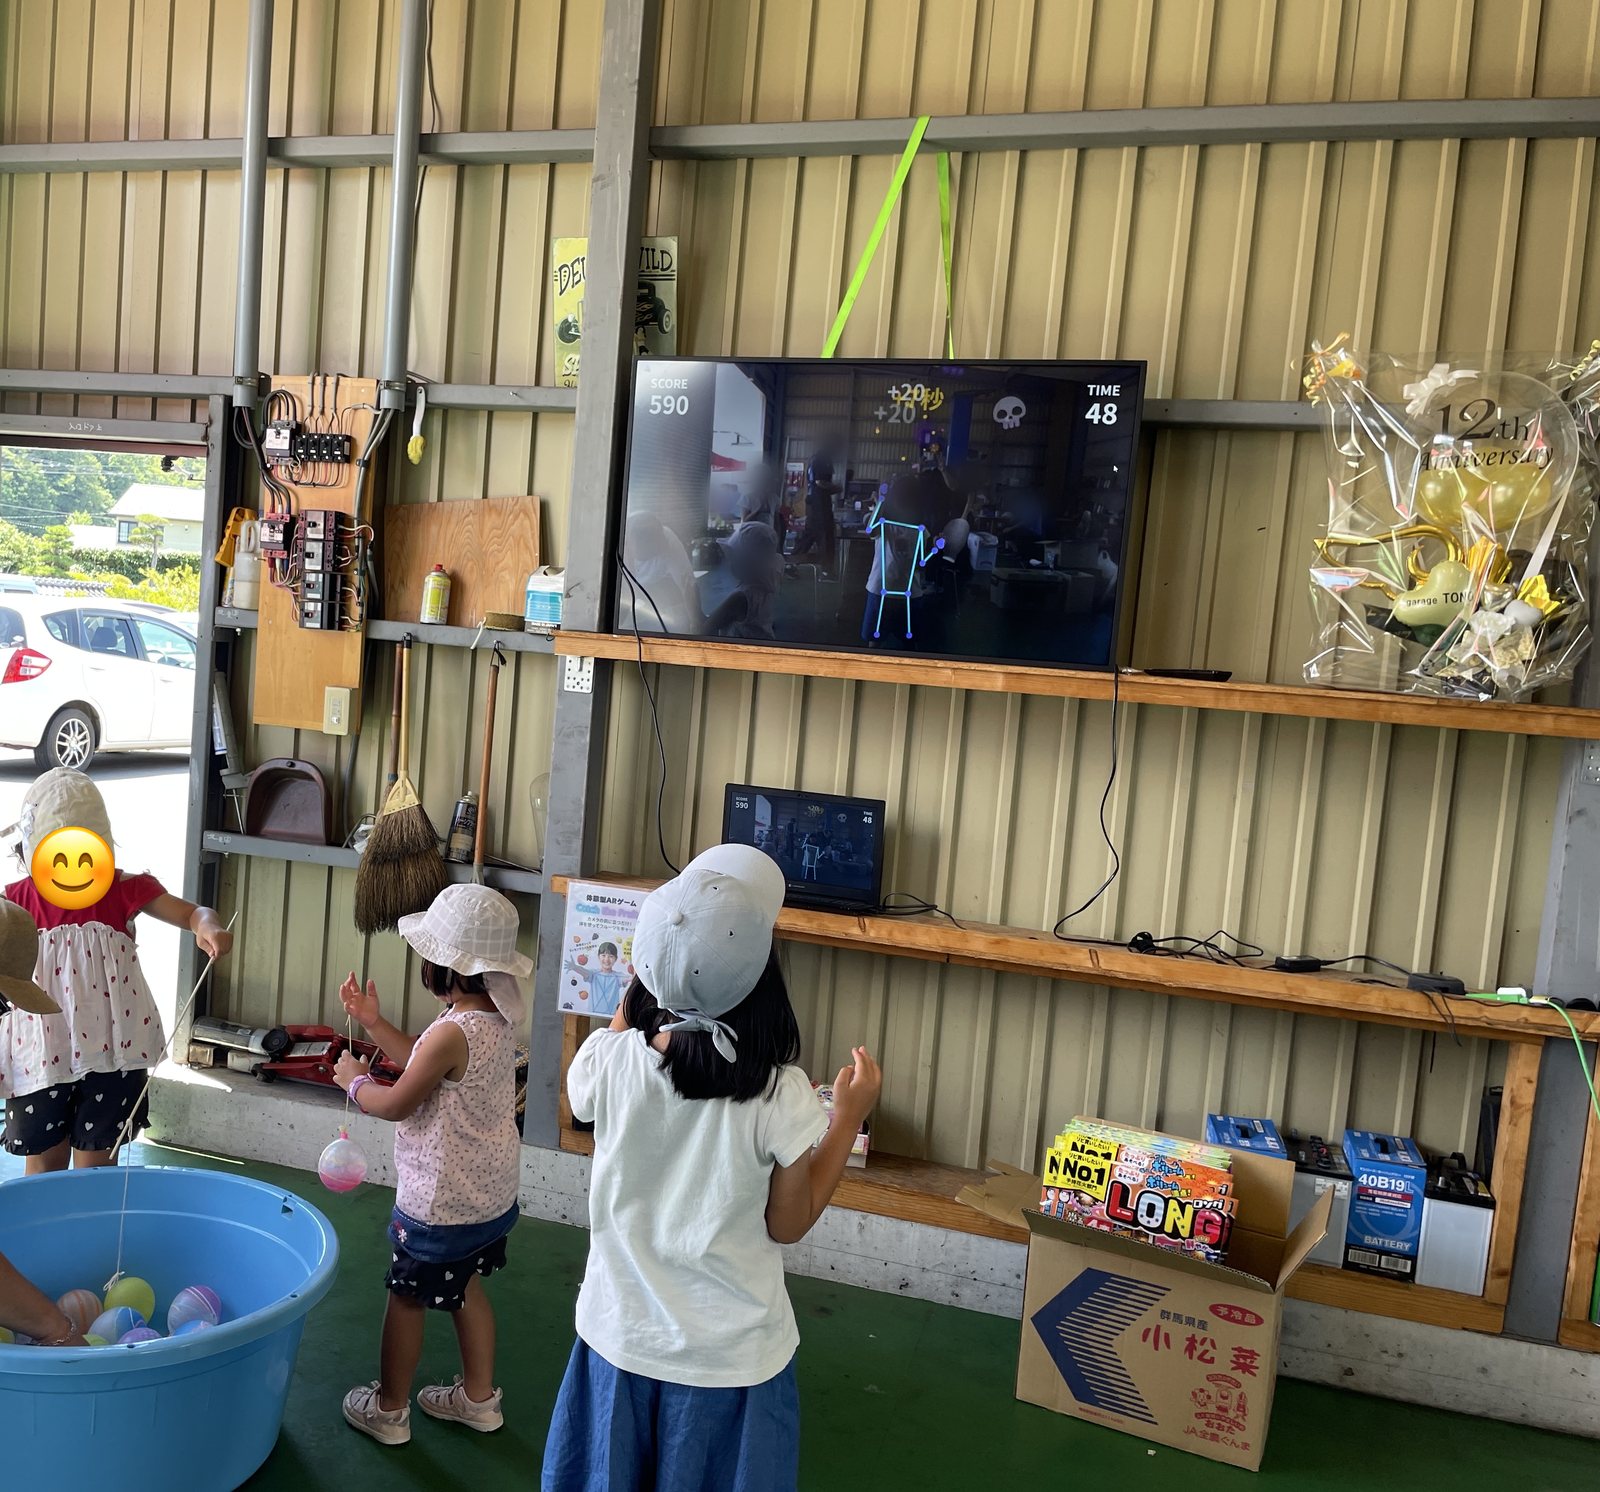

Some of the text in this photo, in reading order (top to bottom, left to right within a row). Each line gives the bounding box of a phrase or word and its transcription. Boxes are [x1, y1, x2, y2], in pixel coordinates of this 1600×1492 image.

[650, 378, 688, 389] SCORE
[1087, 384, 1121, 396] TIME
[649, 395, 689, 415] 590
[1085, 402, 1118, 425] 48
[1406, 597, 1438, 607] garage
[862, 816, 873, 824] 48
[1062, 1157, 1106, 1186] No.1
[1358, 1173, 1414, 1194] 40B19L
[1109, 1182, 1222, 1244] LONG
[1193, 1198, 1225, 1210] ロング
[1364, 1235, 1411, 1251] BATTERY
[1160, 1309, 1209, 1332] 群馬県産
[1217, 1305, 1256, 1324] 予冷品
[1142, 1324, 1261, 1377] 小松菜
[1204, 1420, 1236, 1435] おおた
